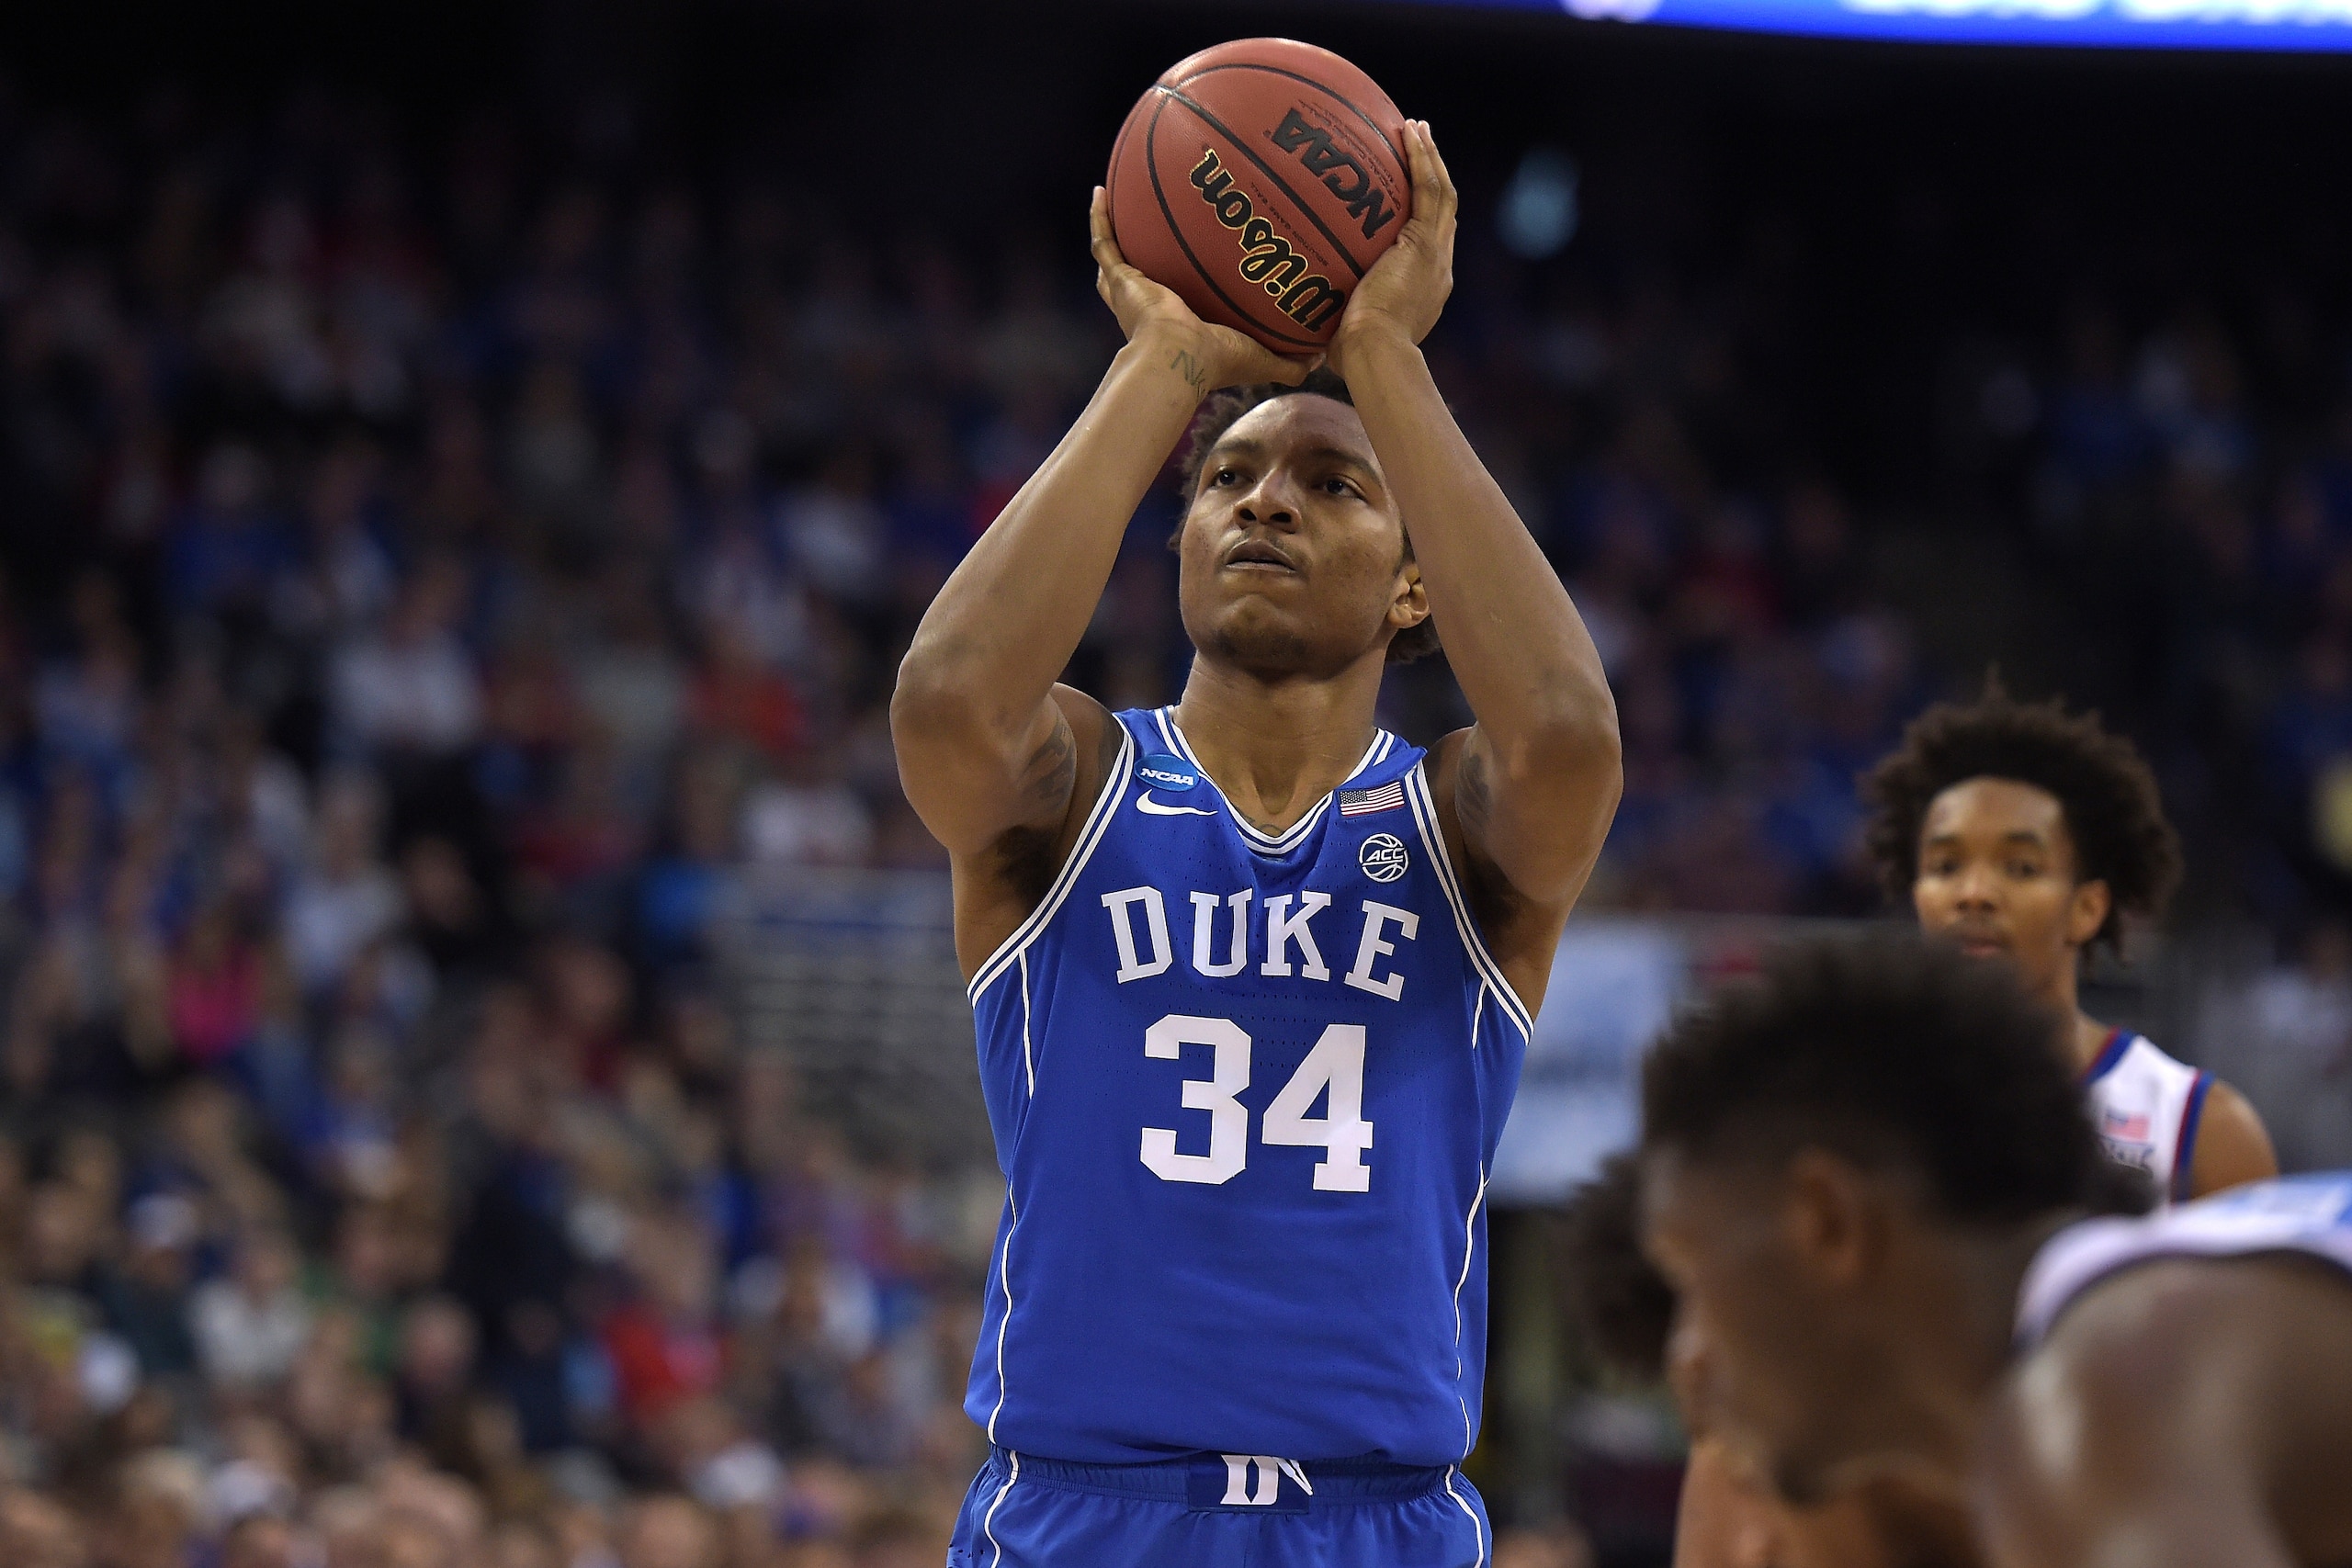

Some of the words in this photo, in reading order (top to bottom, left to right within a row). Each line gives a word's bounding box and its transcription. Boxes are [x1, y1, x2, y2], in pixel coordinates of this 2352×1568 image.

[1272, 107, 1395, 240] NCAA
[1250, 181, 1268, 205] BALL
[1269, 206, 1291, 230] GAME
[1189, 148, 1345, 333] Wilson
[1292, 230, 1329, 266] SOLUTION
[1140, 768, 1193, 785] NCAA
[1366, 848, 1405, 862] ACC
[1102, 886, 1419, 1002] DUKE
[1140, 1014, 1374, 1192] 34
